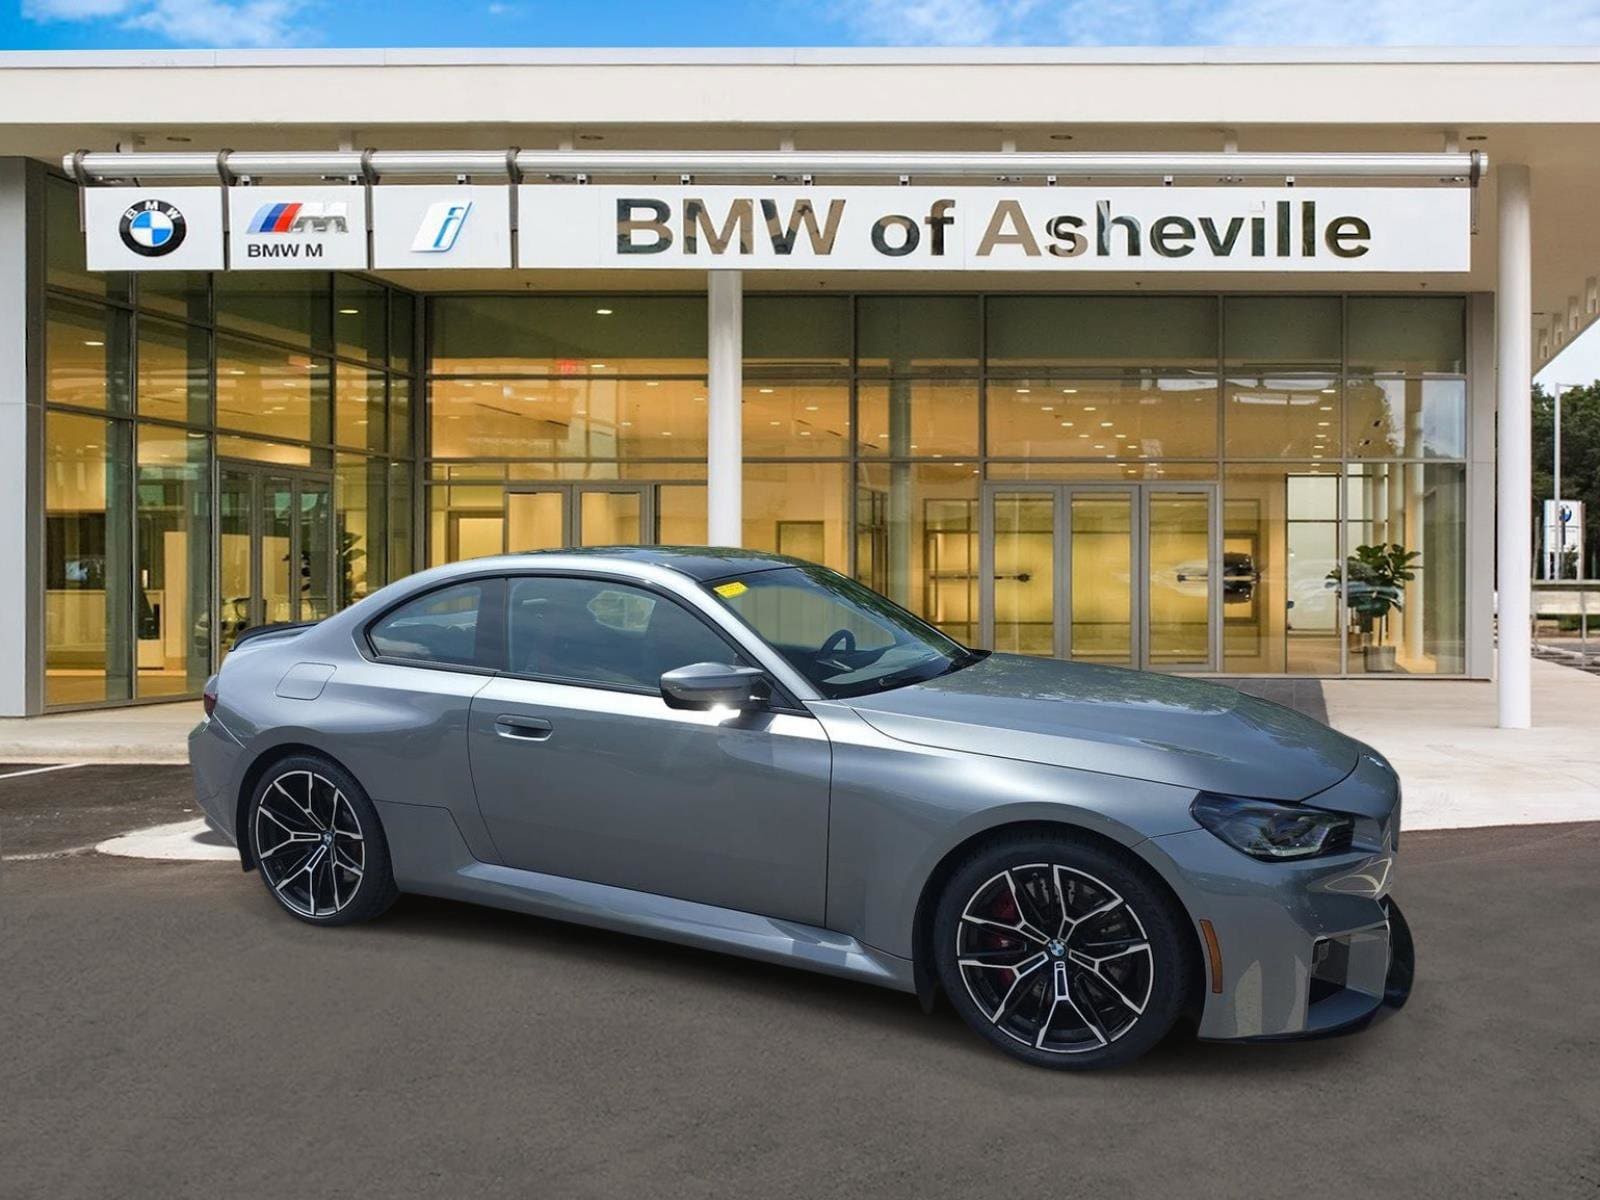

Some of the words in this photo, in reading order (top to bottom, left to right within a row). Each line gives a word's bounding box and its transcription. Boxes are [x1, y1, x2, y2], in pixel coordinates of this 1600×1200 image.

[615, 198, 847, 255] BMW
[870, 199, 957, 257] of
[975, 199, 1372, 258] Asheville
[247, 243, 300, 258] BMW
[304, 243, 323, 257] M
